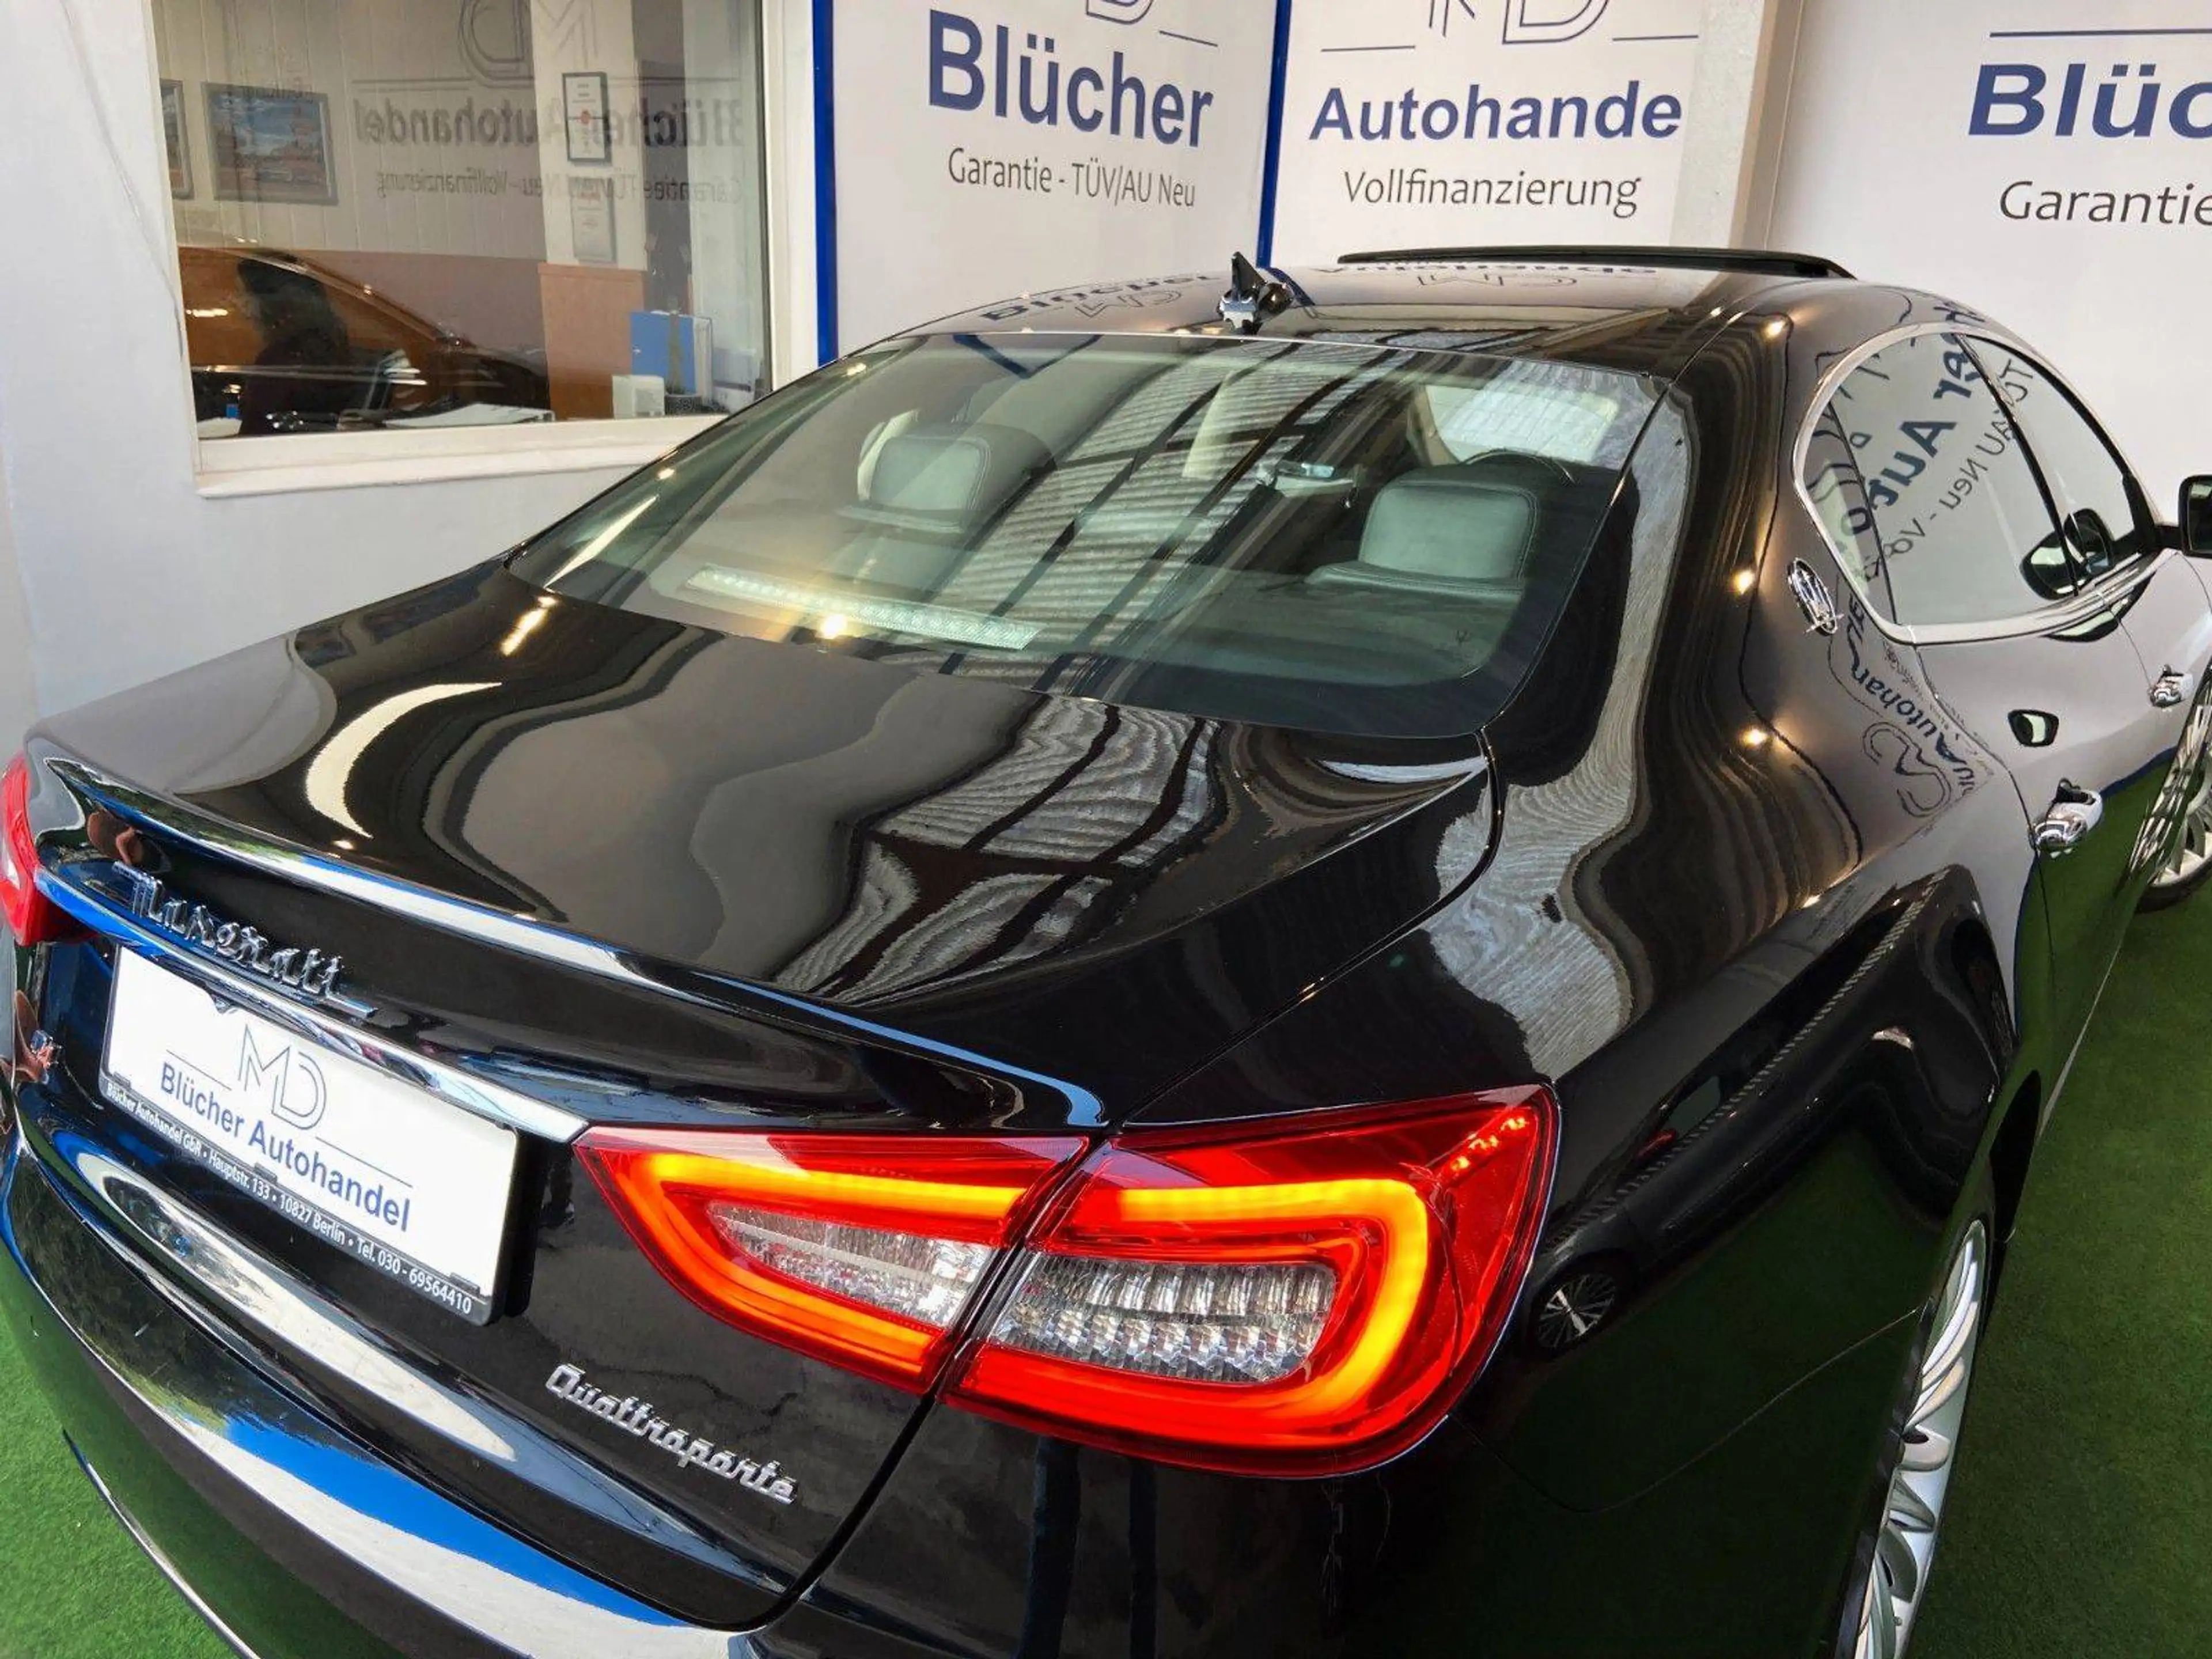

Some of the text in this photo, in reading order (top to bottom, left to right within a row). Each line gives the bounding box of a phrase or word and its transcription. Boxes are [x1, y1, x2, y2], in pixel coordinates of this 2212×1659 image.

[929, 9, 1214, 147] Blücher
[1309, 81, 1682, 140] Autohande
[948, 147, 1052, 193] Garantie
[1071, 157, 1153, 206] TÜV/AU
[1157, 174, 1195, 207] Neu
[1343, 168, 1641, 218] Vollfinanzierung
[1999, 180, 2212, 226] Garantie
[161, 1062, 411, 1232] Blücher Autohandel
[107, 1082, 139, 1112] Blücher
[135, 1100, 184, 1148] Autohandel
[183, 1133, 202, 1157] GbR
[208, 1152, 250, 1189] Hauptstr.
[252, 1179, 271, 1200] 133
[279, 1193, 313, 1224] 10827
[313, 1213, 346, 1247] Berlin
[357, 1237, 377, 1262] Tel.
[378, 1249, 401, 1275] 030
[409, 1268, 472, 1315] 69564410
[544, 1362, 798, 1505] Quattroporte
